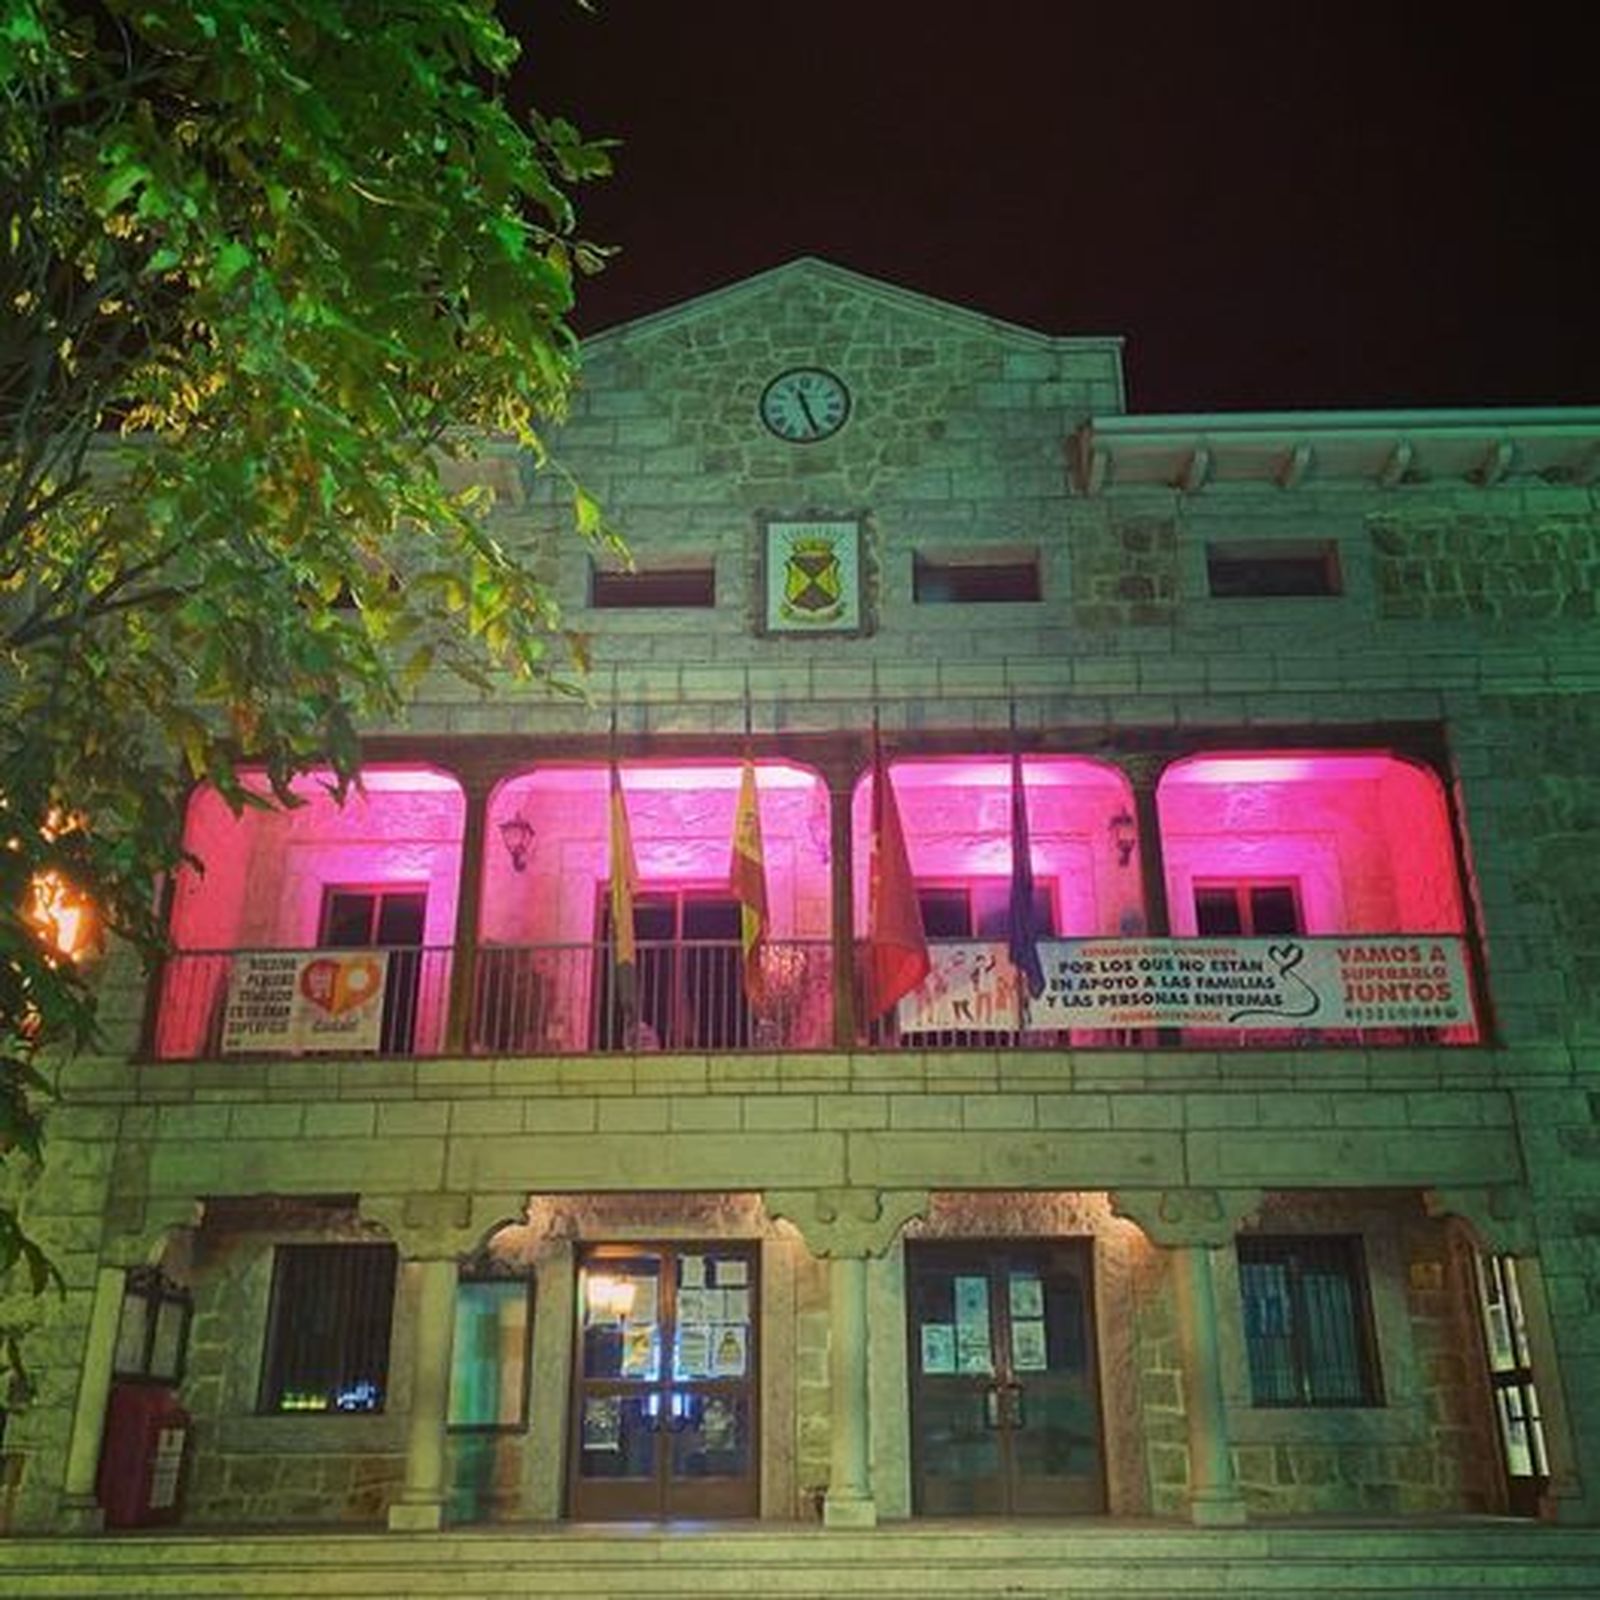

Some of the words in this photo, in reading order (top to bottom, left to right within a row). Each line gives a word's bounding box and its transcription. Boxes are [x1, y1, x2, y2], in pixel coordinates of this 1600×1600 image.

[1337, 945, 1421, 962] VAMOS
[1430, 945, 1446, 961] A
[1059, 961, 1096, 974] POR
[1100, 960, 1133, 973] LOS
[1138, 958, 1174, 971] QUE
[1179, 960, 1204, 972] NO
[1342, 967, 1446, 980] SUPERARLO
[1051, 978, 1072, 991] EN
[1078, 976, 1138, 990] APOYO
[1143, 976, 1156, 988] A
[1161, 976, 1191, 989] LAS
[1196, 976, 1275, 989] FAMILIAS
[1046, 995, 1056, 1008] Y
[1062, 995, 1093, 1008] LAS
[1098, 992, 1188, 1006] PERSONAS
[1195, 993, 1283, 1007] ENFERMAS
[1344, 983, 1452, 1002] JUNTOS
